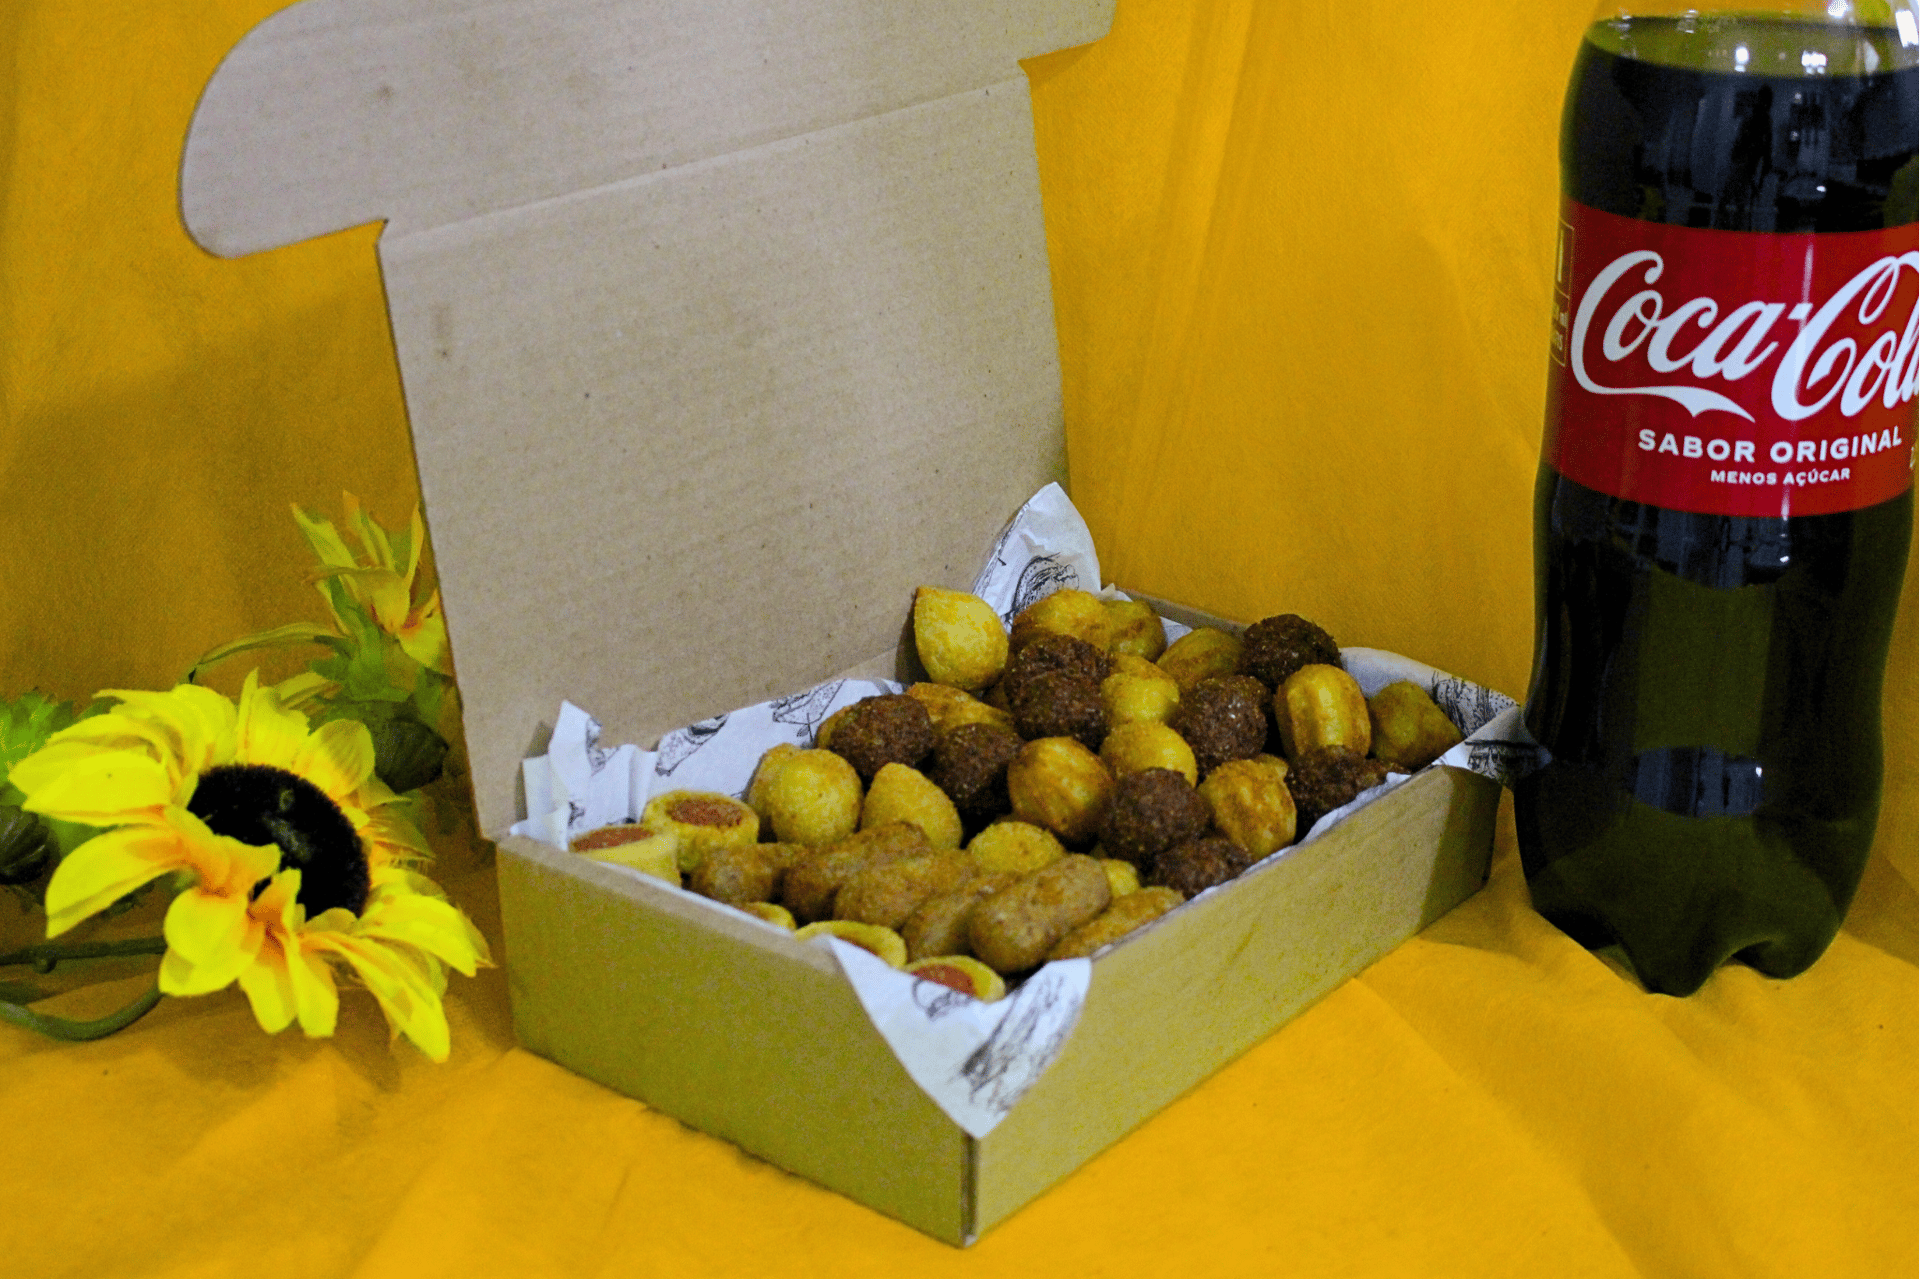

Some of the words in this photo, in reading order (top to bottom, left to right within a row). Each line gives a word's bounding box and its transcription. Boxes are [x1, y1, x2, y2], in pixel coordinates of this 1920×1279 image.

[1638, 428, 1756, 463] SABOR
[1769, 425, 1903, 464] ORIGINAL
[1710, 469, 1777, 485] MENOS
[1782, 467, 1851, 487] AÇÚCAR
